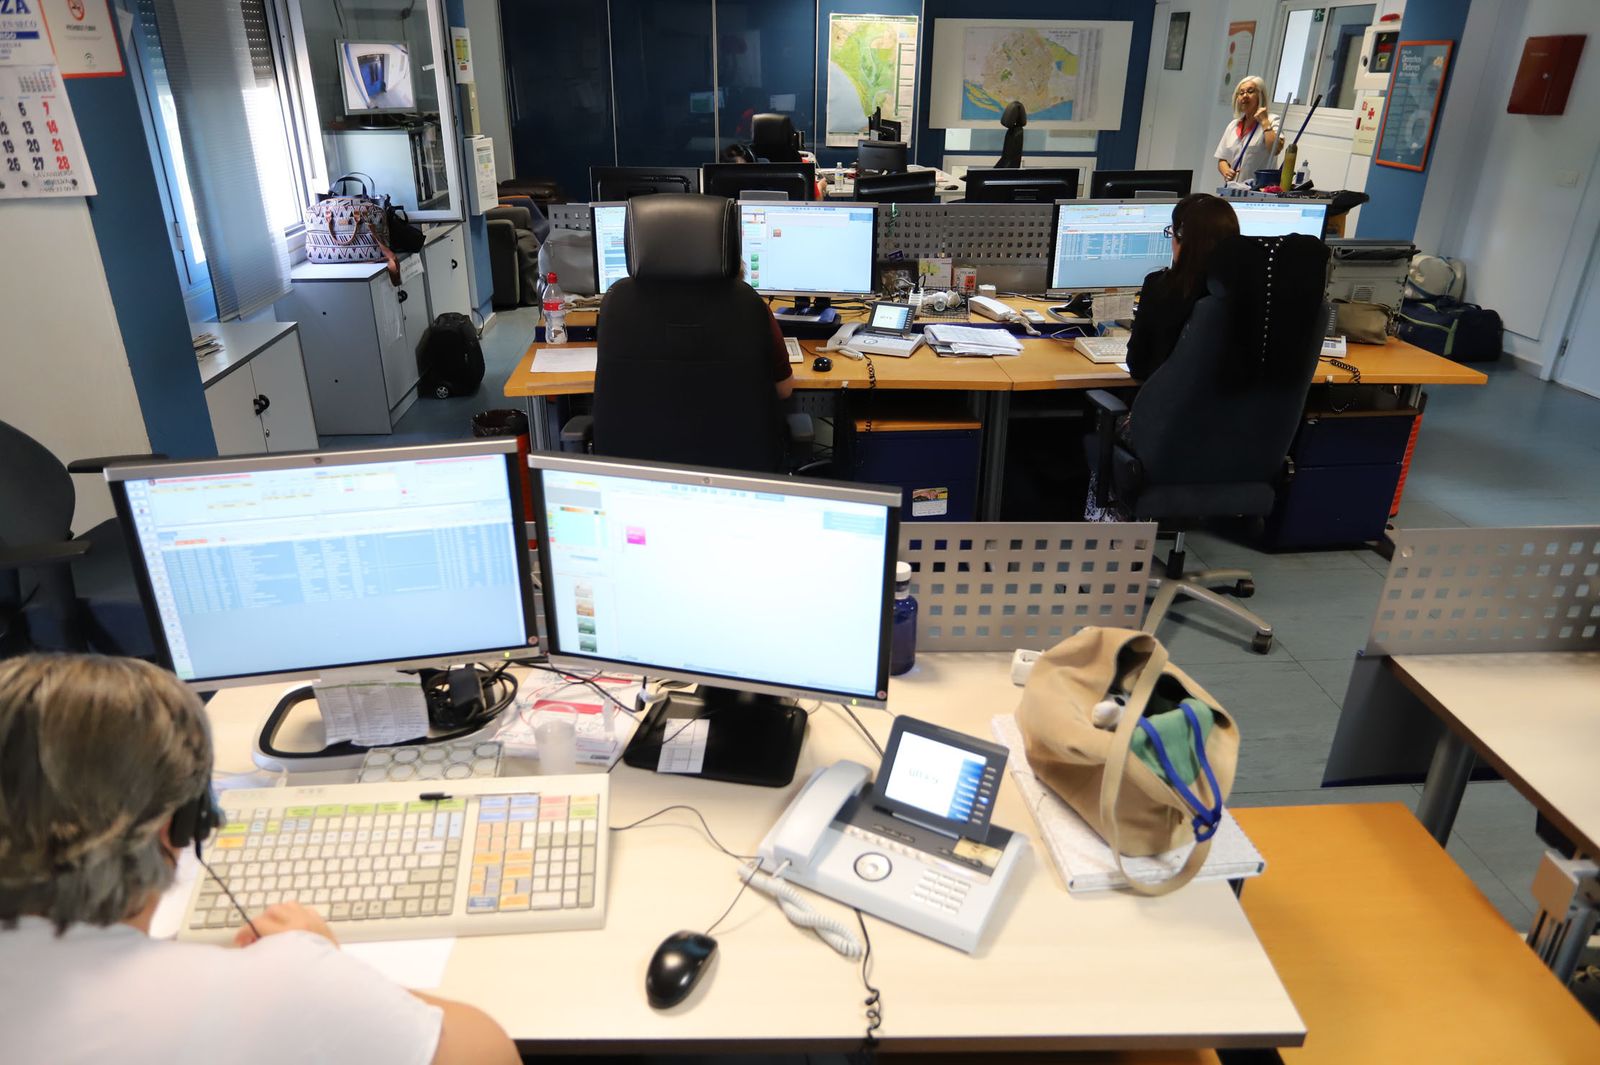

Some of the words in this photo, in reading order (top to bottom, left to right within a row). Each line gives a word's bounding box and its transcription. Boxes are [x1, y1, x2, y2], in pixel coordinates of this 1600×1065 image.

[18, 102, 26, 116] 6
[43, 101, 49, 116] 7
[0, 121, 9, 135] 12
[22, 120, 34, 135] 13
[46, 120, 58, 134] 14
[3, 139, 14, 154] 19
[26, 139, 40, 152] 20
[52, 138, 64, 152] 21
[7, 157, 21, 171] 26
[32, 157, 44, 170] 27
[56, 155, 70, 170] 28
